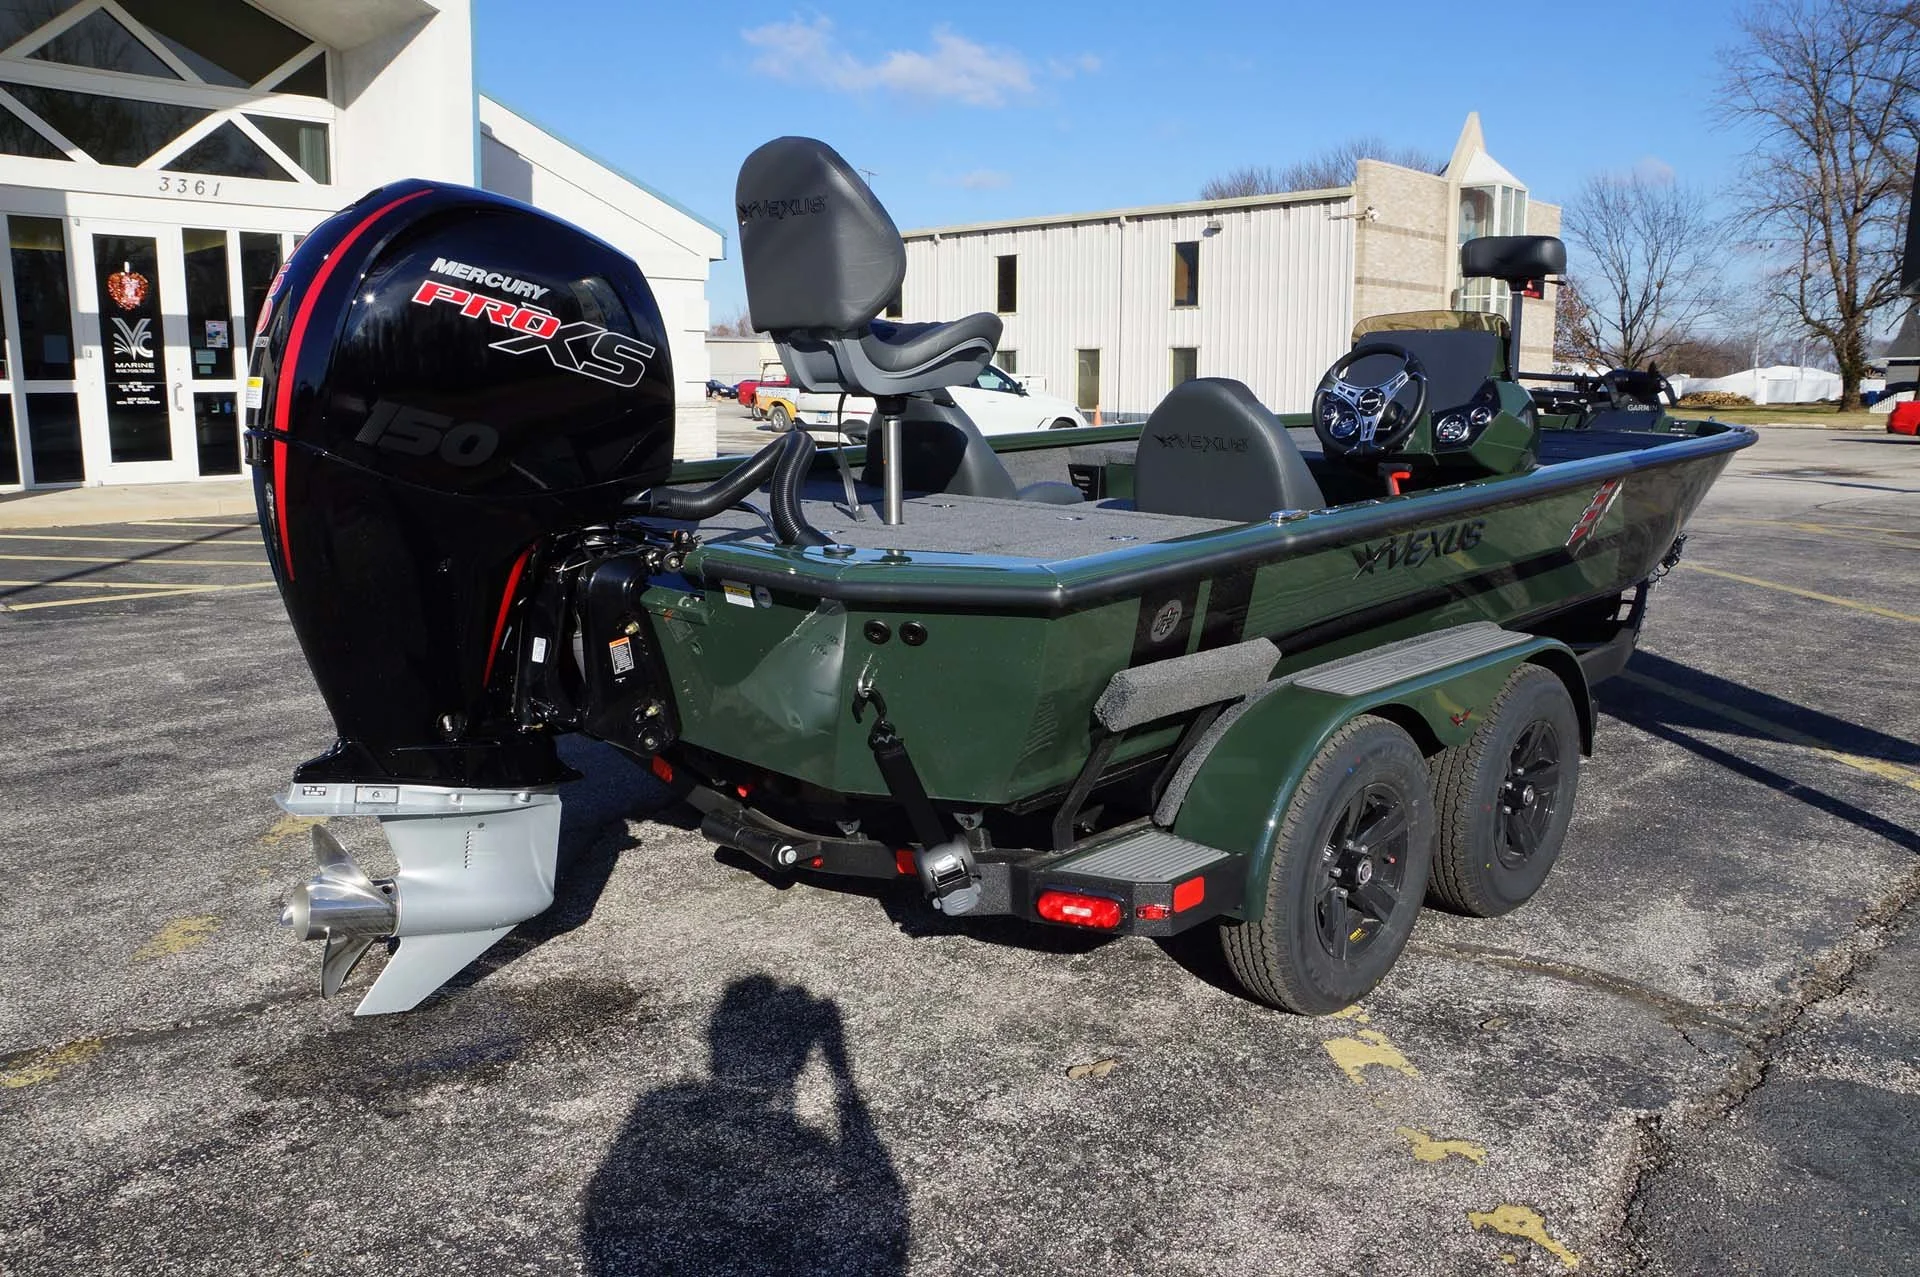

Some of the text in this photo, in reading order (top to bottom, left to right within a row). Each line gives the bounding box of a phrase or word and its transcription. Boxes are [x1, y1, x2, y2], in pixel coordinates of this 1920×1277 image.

[158, 176, 220, 196] 3361
[755, 196, 827, 220] VEXUS
[430, 256, 550, 301] MERCURY
[411, 279, 656, 388] PRO XS
[1627, 404, 1658, 412] GARMIN
[354, 400, 499, 467] 150
[1387, 518, 1487, 570] VEXUS
